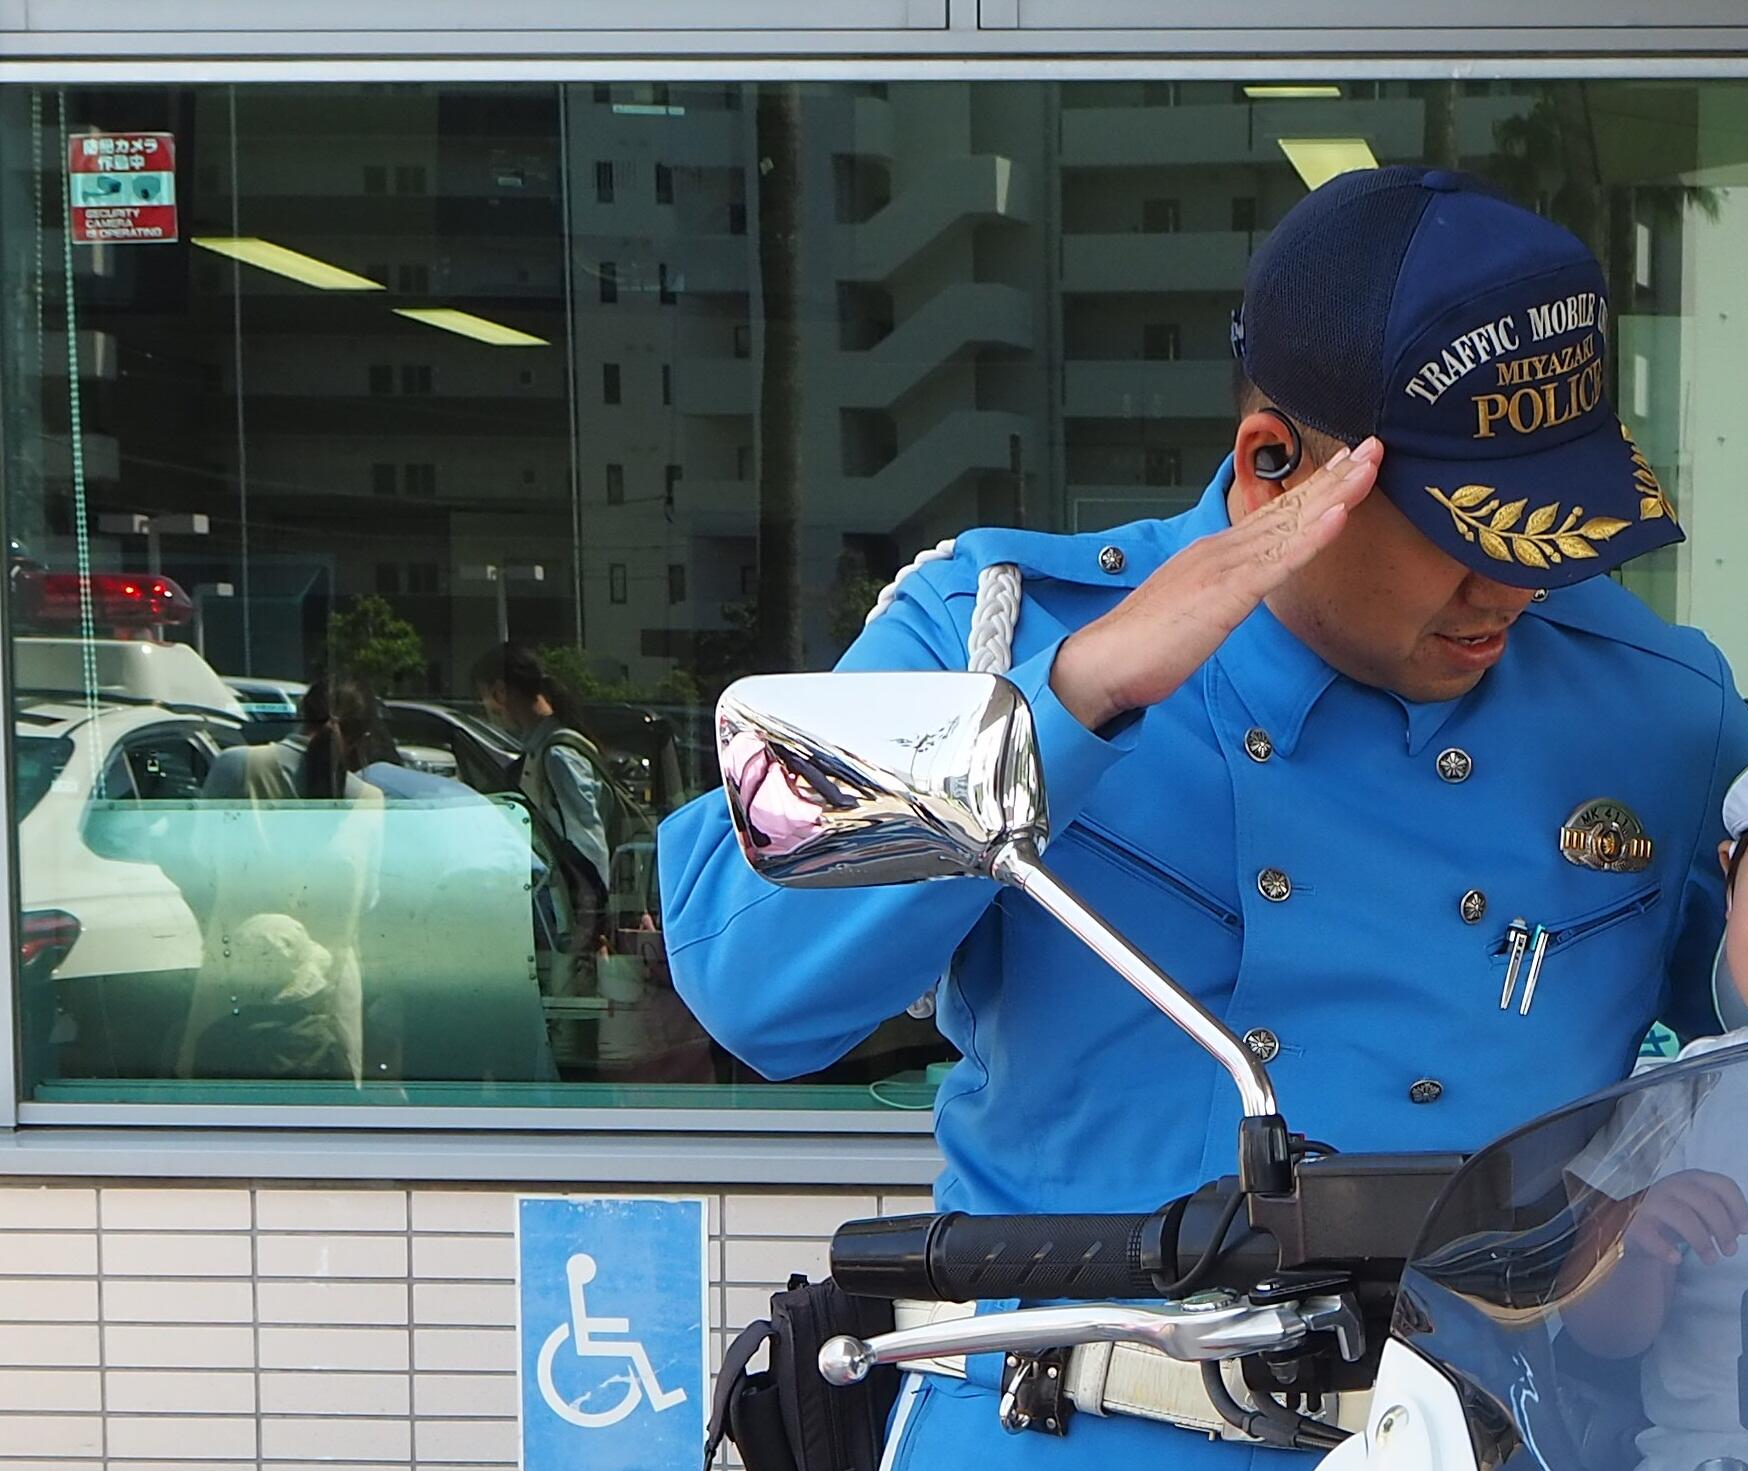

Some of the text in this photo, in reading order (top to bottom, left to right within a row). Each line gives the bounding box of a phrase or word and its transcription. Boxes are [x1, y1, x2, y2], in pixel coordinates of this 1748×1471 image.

[86, 208, 140, 218] SECURITY
[86, 218, 133, 228] CAMERA
[100, 227, 162, 237] OPERATING
[1405, 315, 1520, 405] TRAFFIC
[1527, 292, 1596, 343] MOBILE
[1496, 333, 1595, 386] MIYAZAKI
[1471, 357, 1603, 439] POLICE
[1581, 807, 1599, 825] MK
